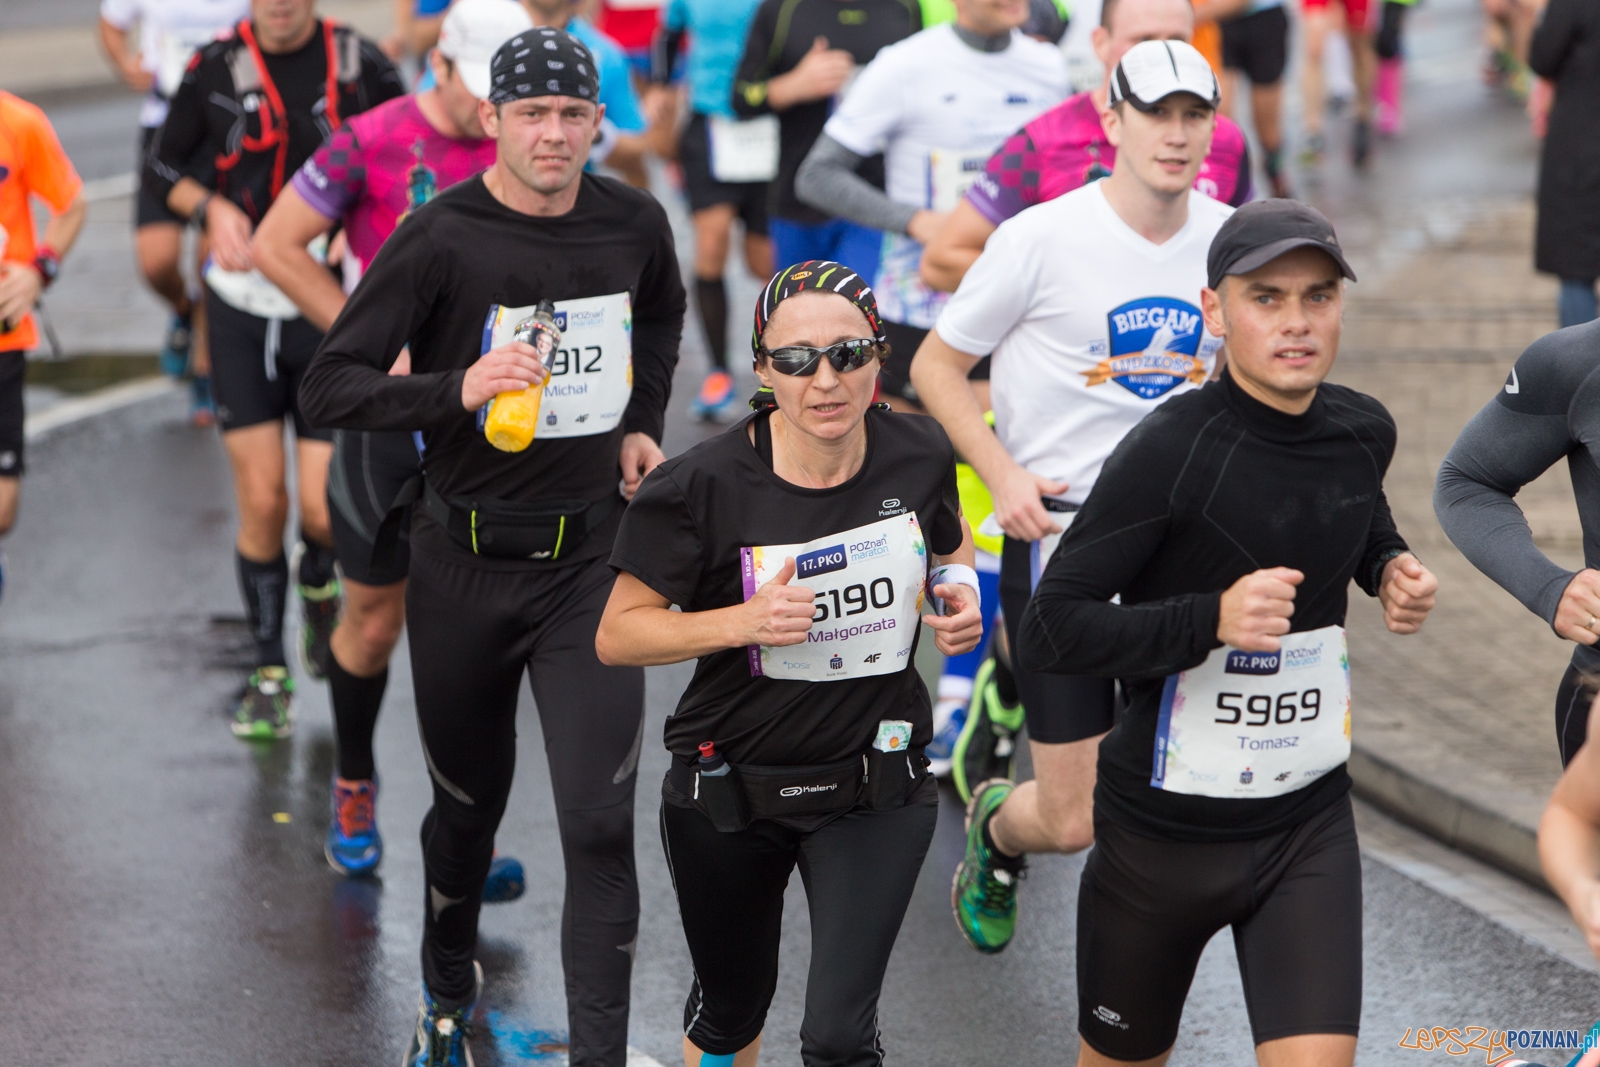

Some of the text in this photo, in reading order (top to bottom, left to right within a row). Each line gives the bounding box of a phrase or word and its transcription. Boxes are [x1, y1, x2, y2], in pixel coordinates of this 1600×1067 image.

[1113, 307, 1200, 335] BIEGAM
[545, 382, 587, 397] Michał
[878, 506, 908, 517] Kalenji
[851, 545, 889, 561] maraton
[812, 577, 894, 623] 5190
[807, 618, 897, 643] Małgorzata
[1215, 688, 1321, 726] 5969
[1237, 736, 1299, 750] Tomasz
[803, 782, 838, 793] Kalenji
